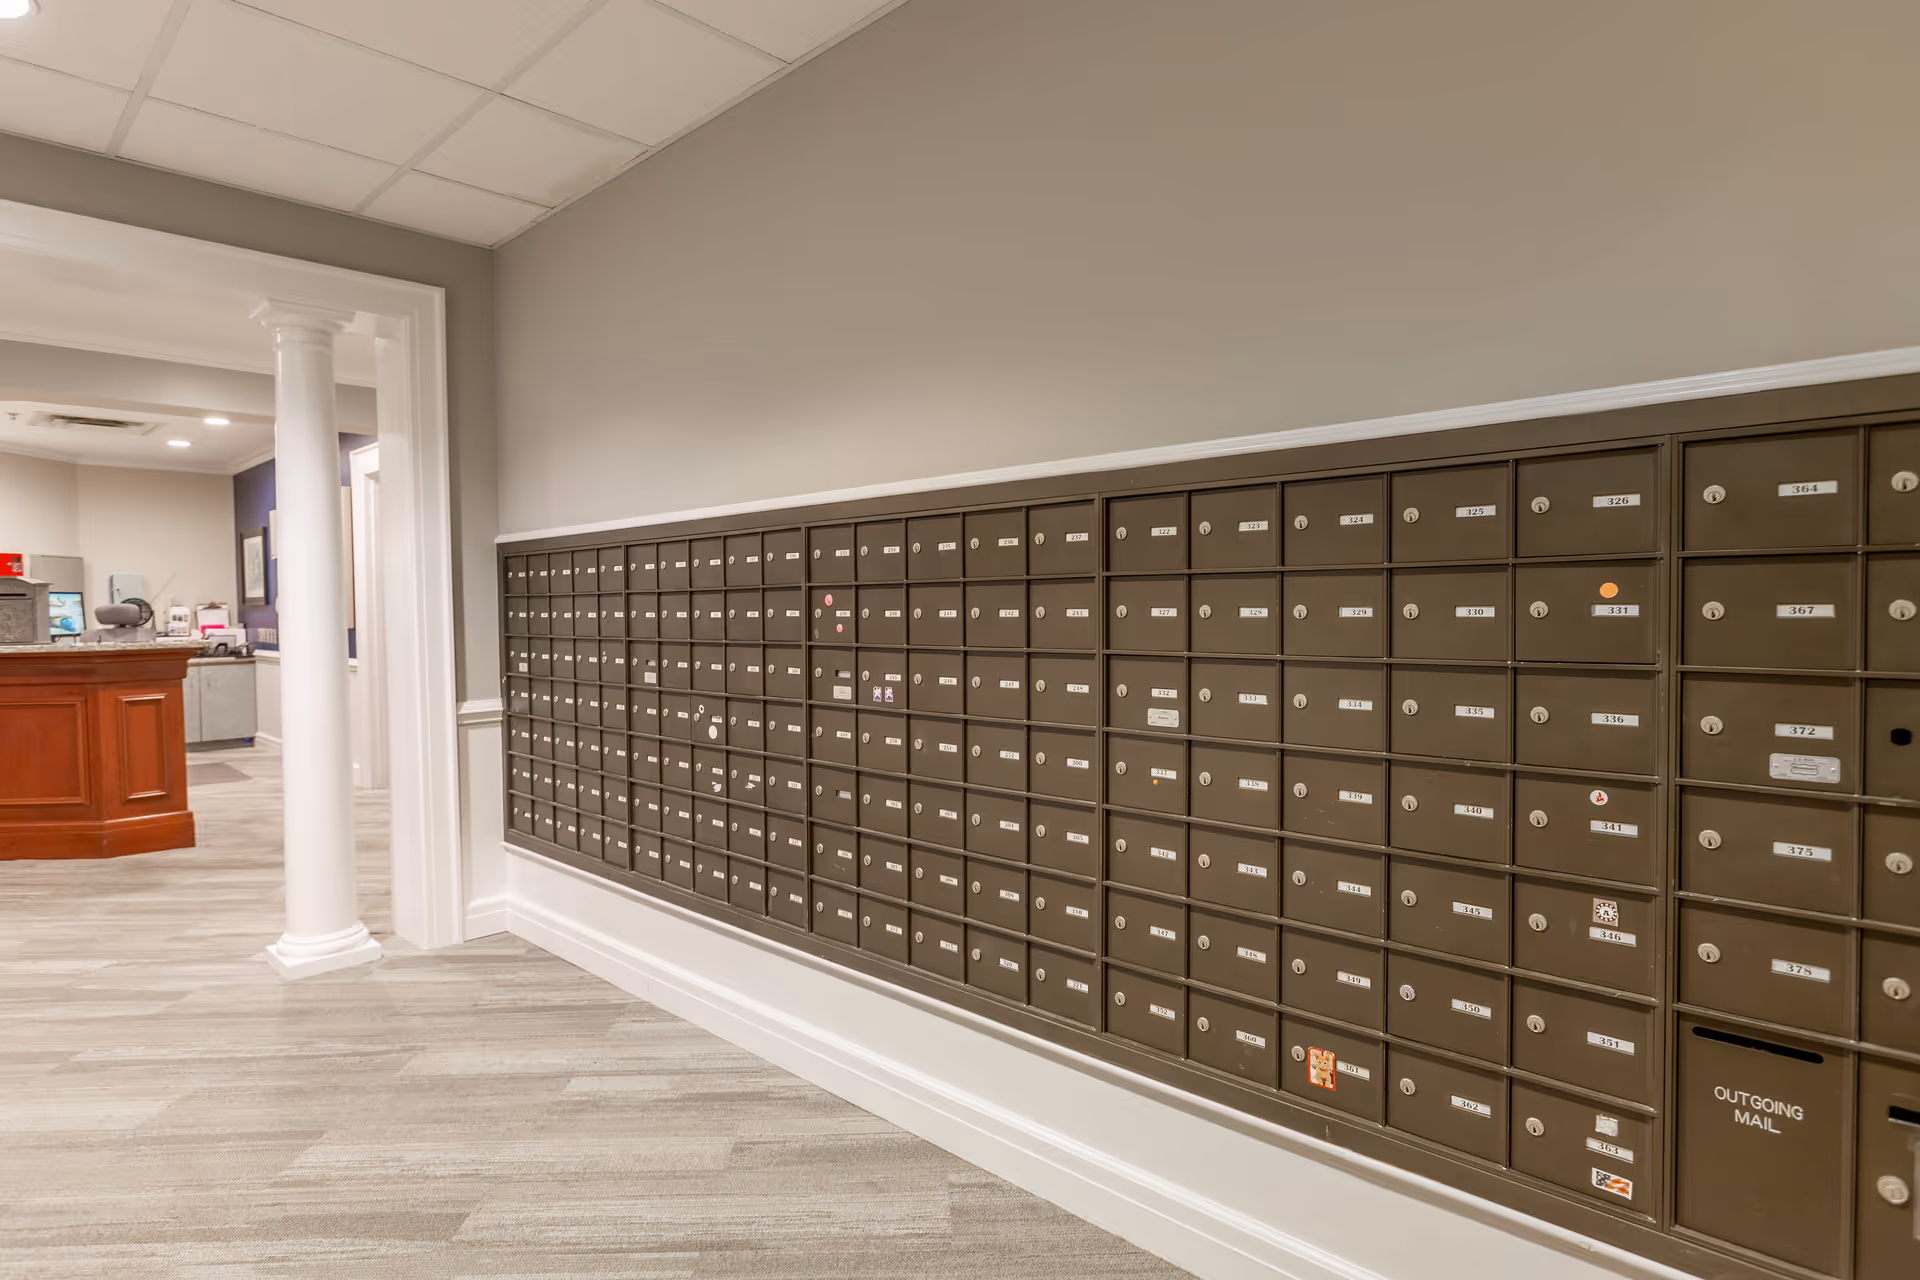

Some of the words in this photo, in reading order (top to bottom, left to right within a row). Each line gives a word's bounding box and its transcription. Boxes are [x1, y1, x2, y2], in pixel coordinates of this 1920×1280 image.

[1792, 484, 1818, 494] 364
[1607, 497, 1629, 506] 326
[1465, 508, 1484, 516] 325
[1351, 608, 1367, 616] 329
[1607, 606, 1628, 615] 331
[1789, 606, 1815, 615] 367
[1602, 714, 1624, 724] 336
[1790, 726, 1816, 736] 372
[1463, 806, 1482, 814] 340
[1601, 822, 1622, 832] 341
[1787, 846, 1813, 857] 375
[1346, 885, 1361, 893] 344
[1462, 906, 1481, 915] 345
[1600, 930, 1621, 941] 346
[1786, 963, 1812, 976] 378
[1346, 975, 1361, 984] 349
[1461, 1003, 1480, 1013] 350
[1599, 1036, 1619, 1048] 351
[1343, 1063, 1360, 1074] 361
[1460, 1100, 1478, 1111] 362
[1714, 1086, 1804, 1120] OUTGOING
[1734, 1109, 1782, 1134] MAIL
[1597, 1141, 1619, 1155] 363
